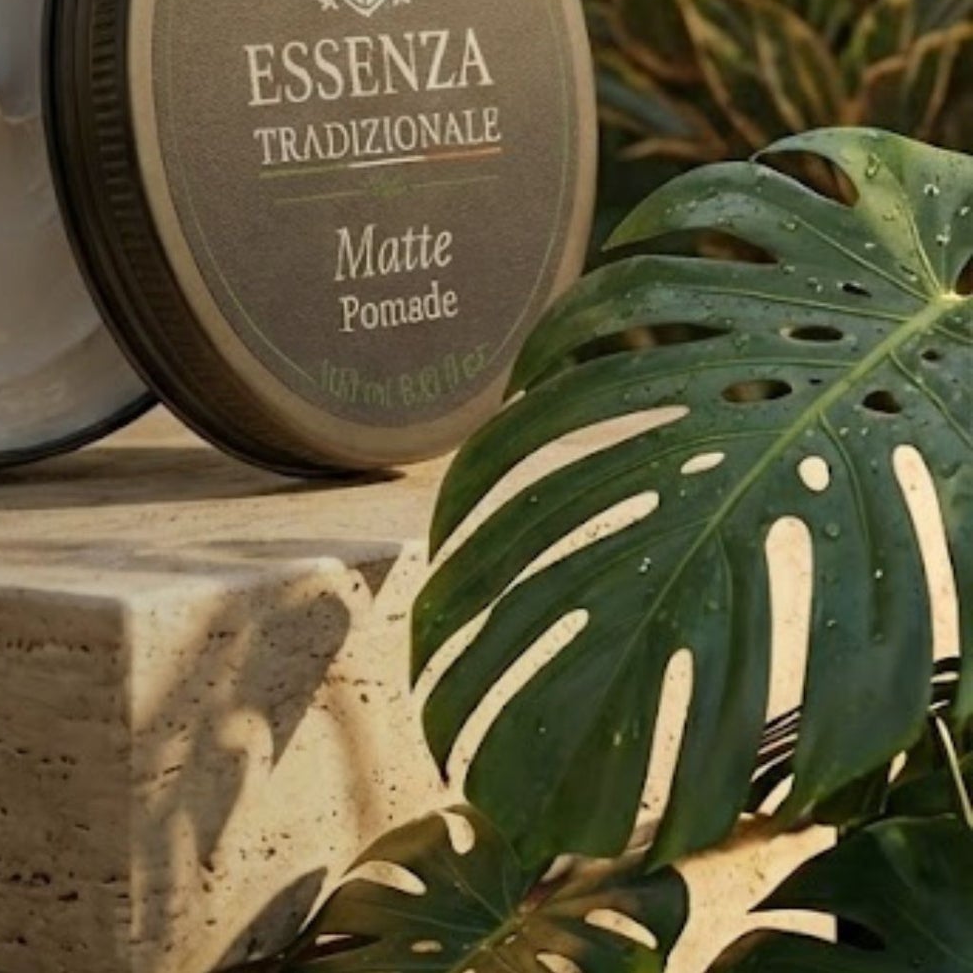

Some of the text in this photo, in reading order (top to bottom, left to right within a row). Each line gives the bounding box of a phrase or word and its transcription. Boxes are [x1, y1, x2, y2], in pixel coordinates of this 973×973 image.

[243, 27, 496, 106] ESSENZA
[252, 106, 503, 166] TRADIZIONALE
[333, 222, 453, 282] Matte
[337, 279, 459, 333] Pomade
